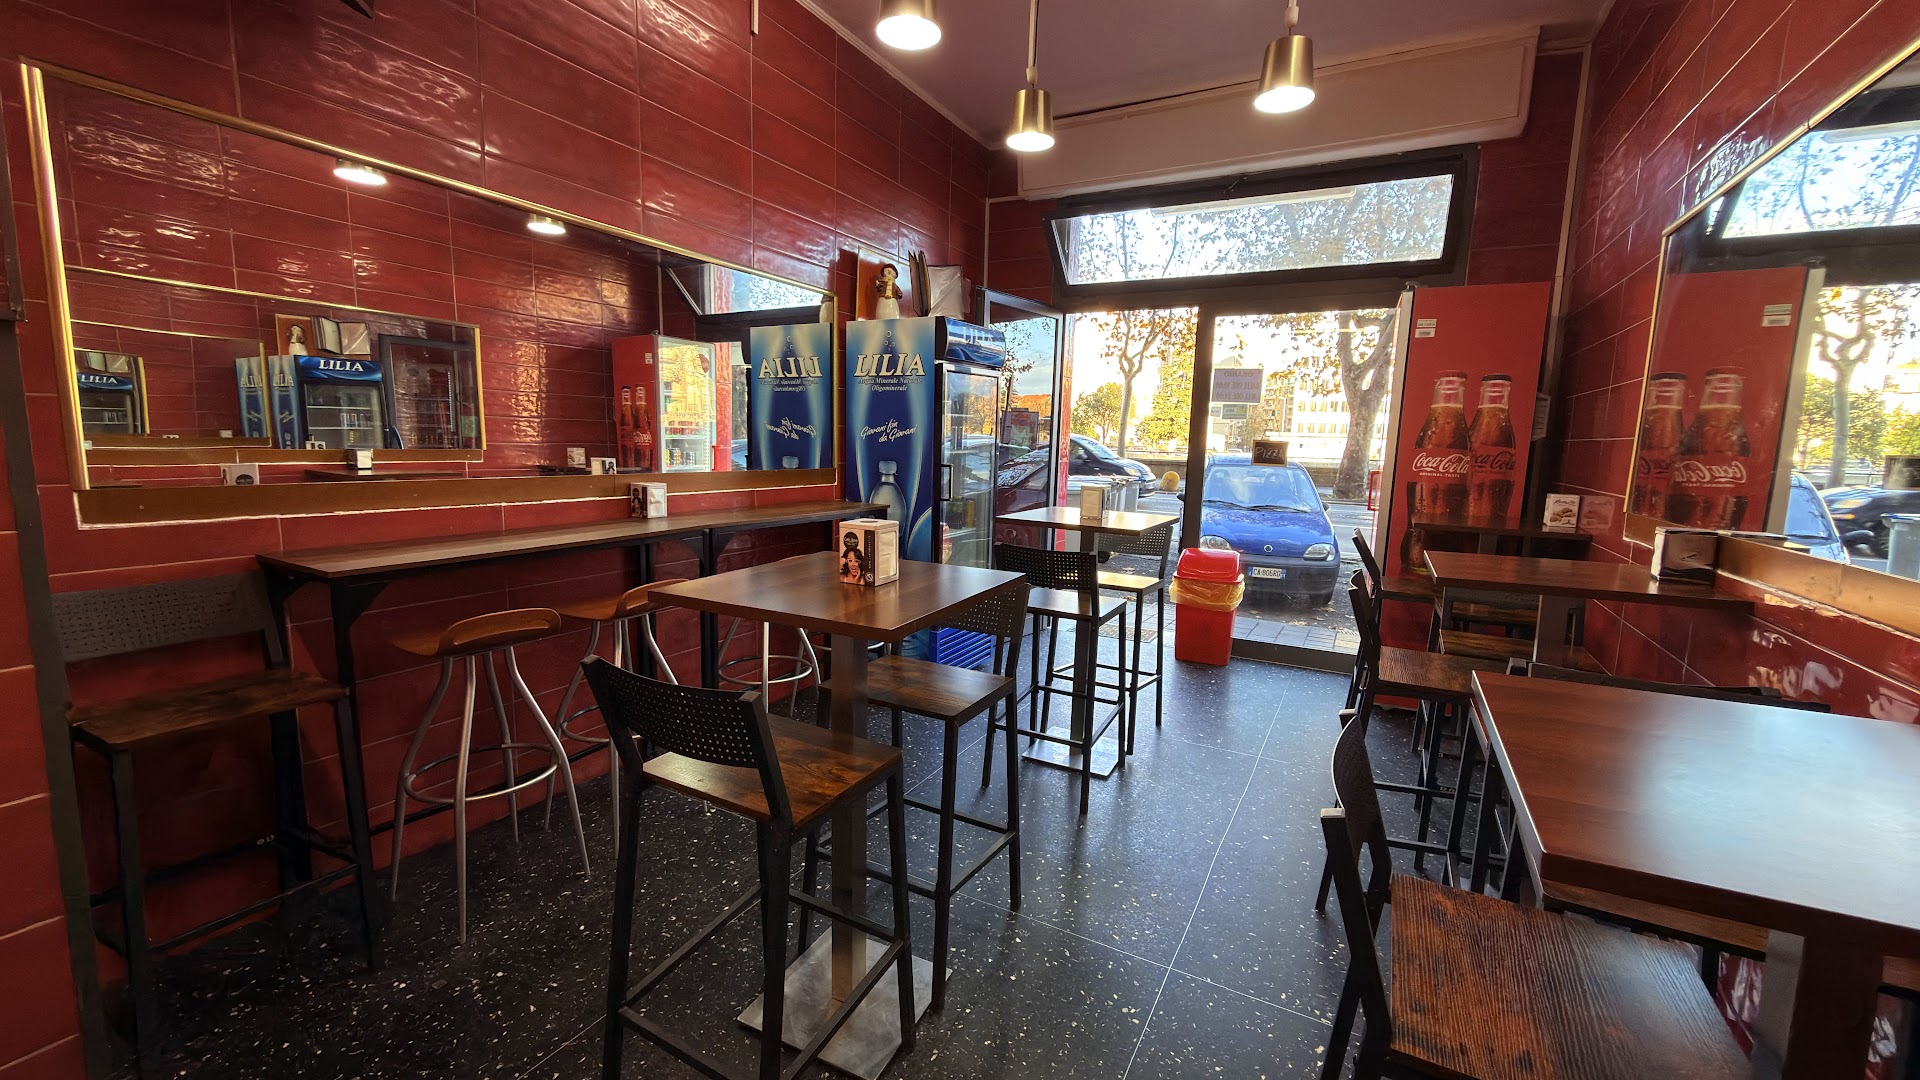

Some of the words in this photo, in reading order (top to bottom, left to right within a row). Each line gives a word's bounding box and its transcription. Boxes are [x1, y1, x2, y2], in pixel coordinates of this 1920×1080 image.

[319, 359, 364, 372] LILIA
[854, 353, 926, 377] LILIA
[81, 374, 118, 385] LILIA
[861, 422, 887, 439] Giovani
[879, 433, 888, 443] da
[889, 424, 917, 442] Giovani
[1412, 452, 1470, 474] Coca-Cola
